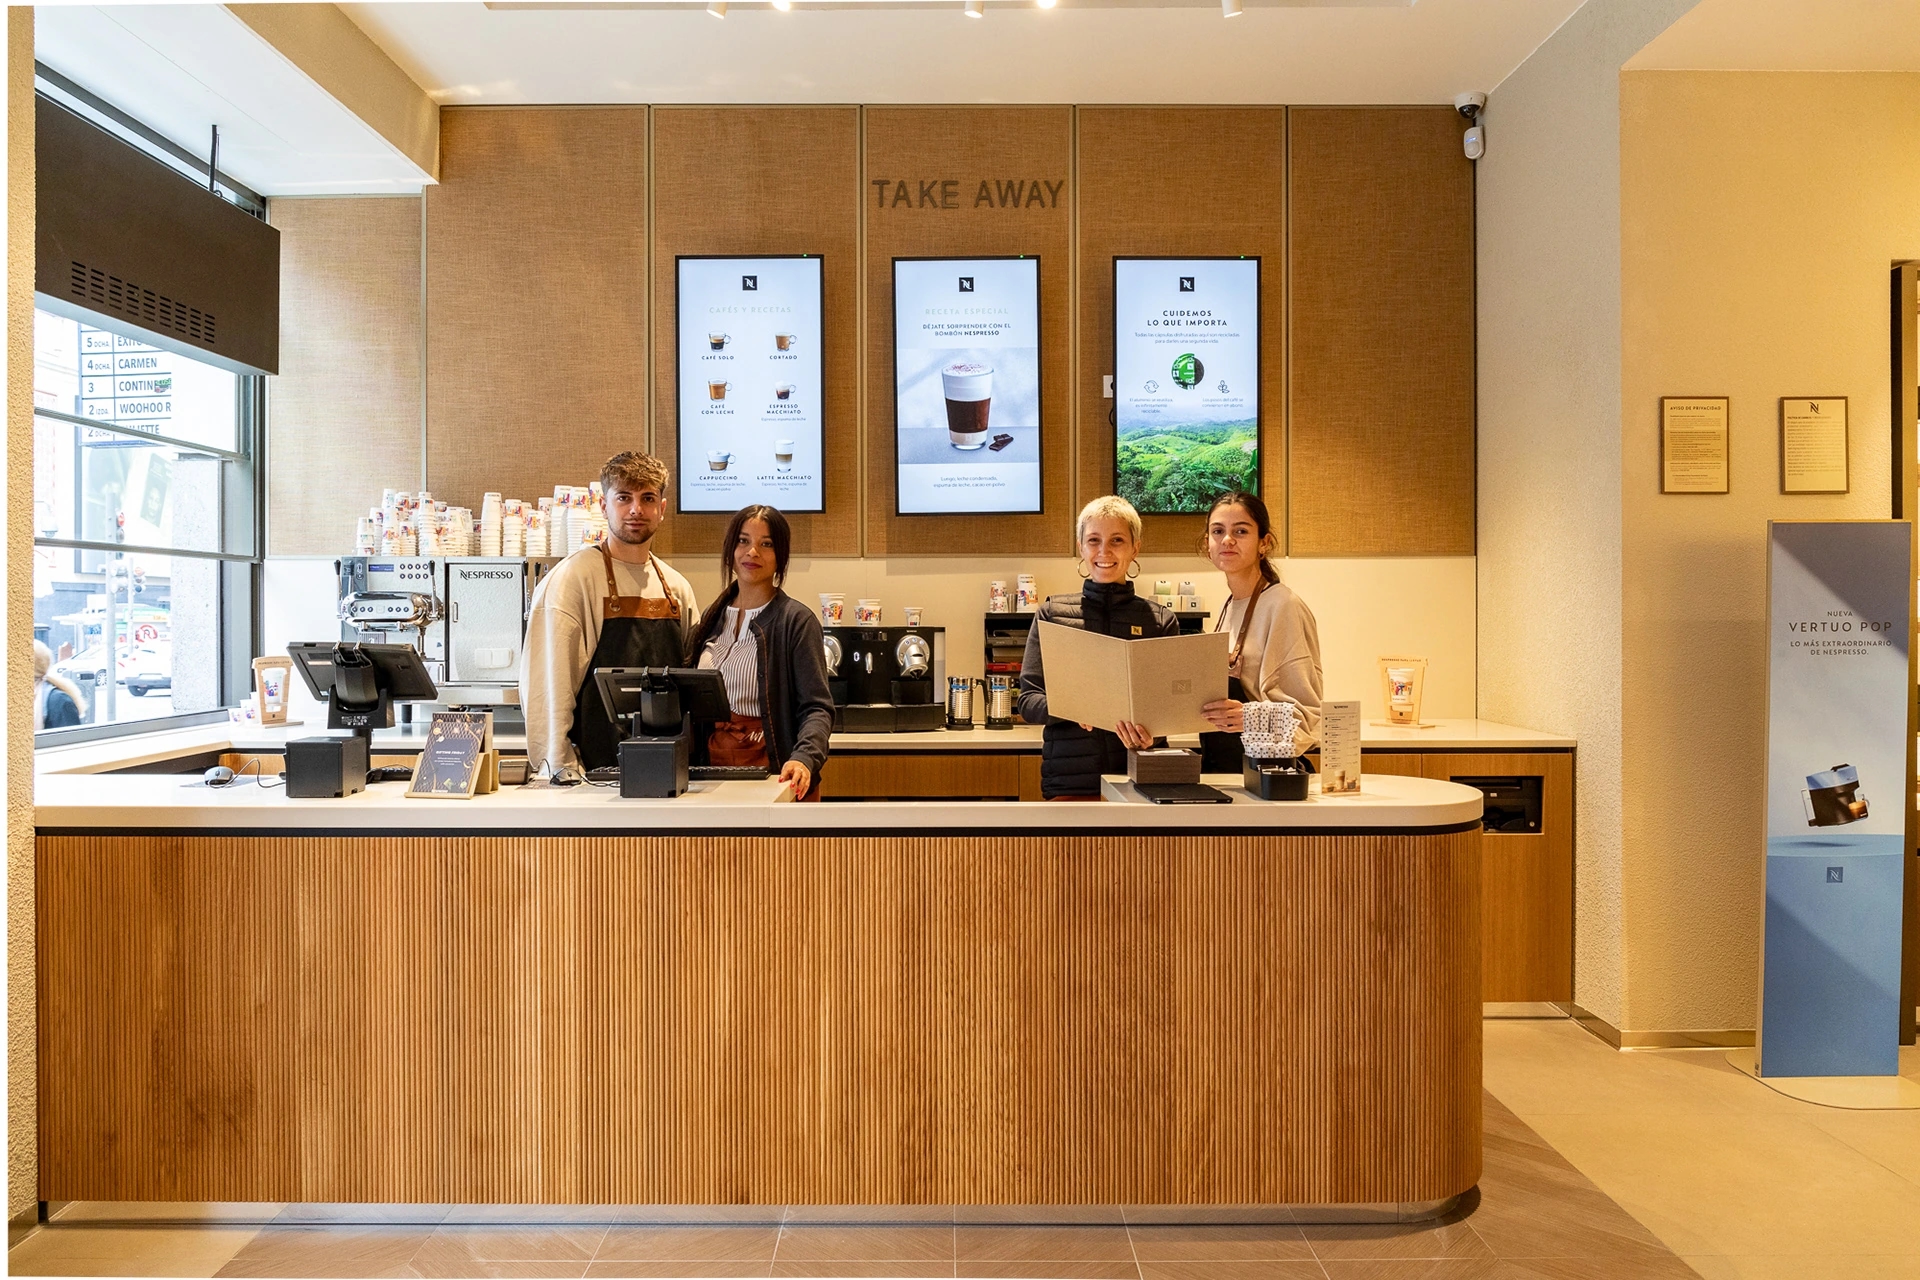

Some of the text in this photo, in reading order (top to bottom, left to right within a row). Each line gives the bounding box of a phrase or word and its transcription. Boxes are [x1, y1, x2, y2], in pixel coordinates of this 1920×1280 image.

[872, 180, 1064, 208] TAKE AWAY
[709, 305, 738, 313] CAFÉS
[86, 337, 93, 347] 5
[87, 359, 93, 370] 4
[118, 358, 157, 369] CARMEN
[88, 382, 94, 392] 3
[89, 405, 94, 415] 2
[120, 402, 163, 413] WOOHOO
[460, 569, 513, 580] NESPRESSO
[1789, 622, 1892, 632] VERTUO POP
